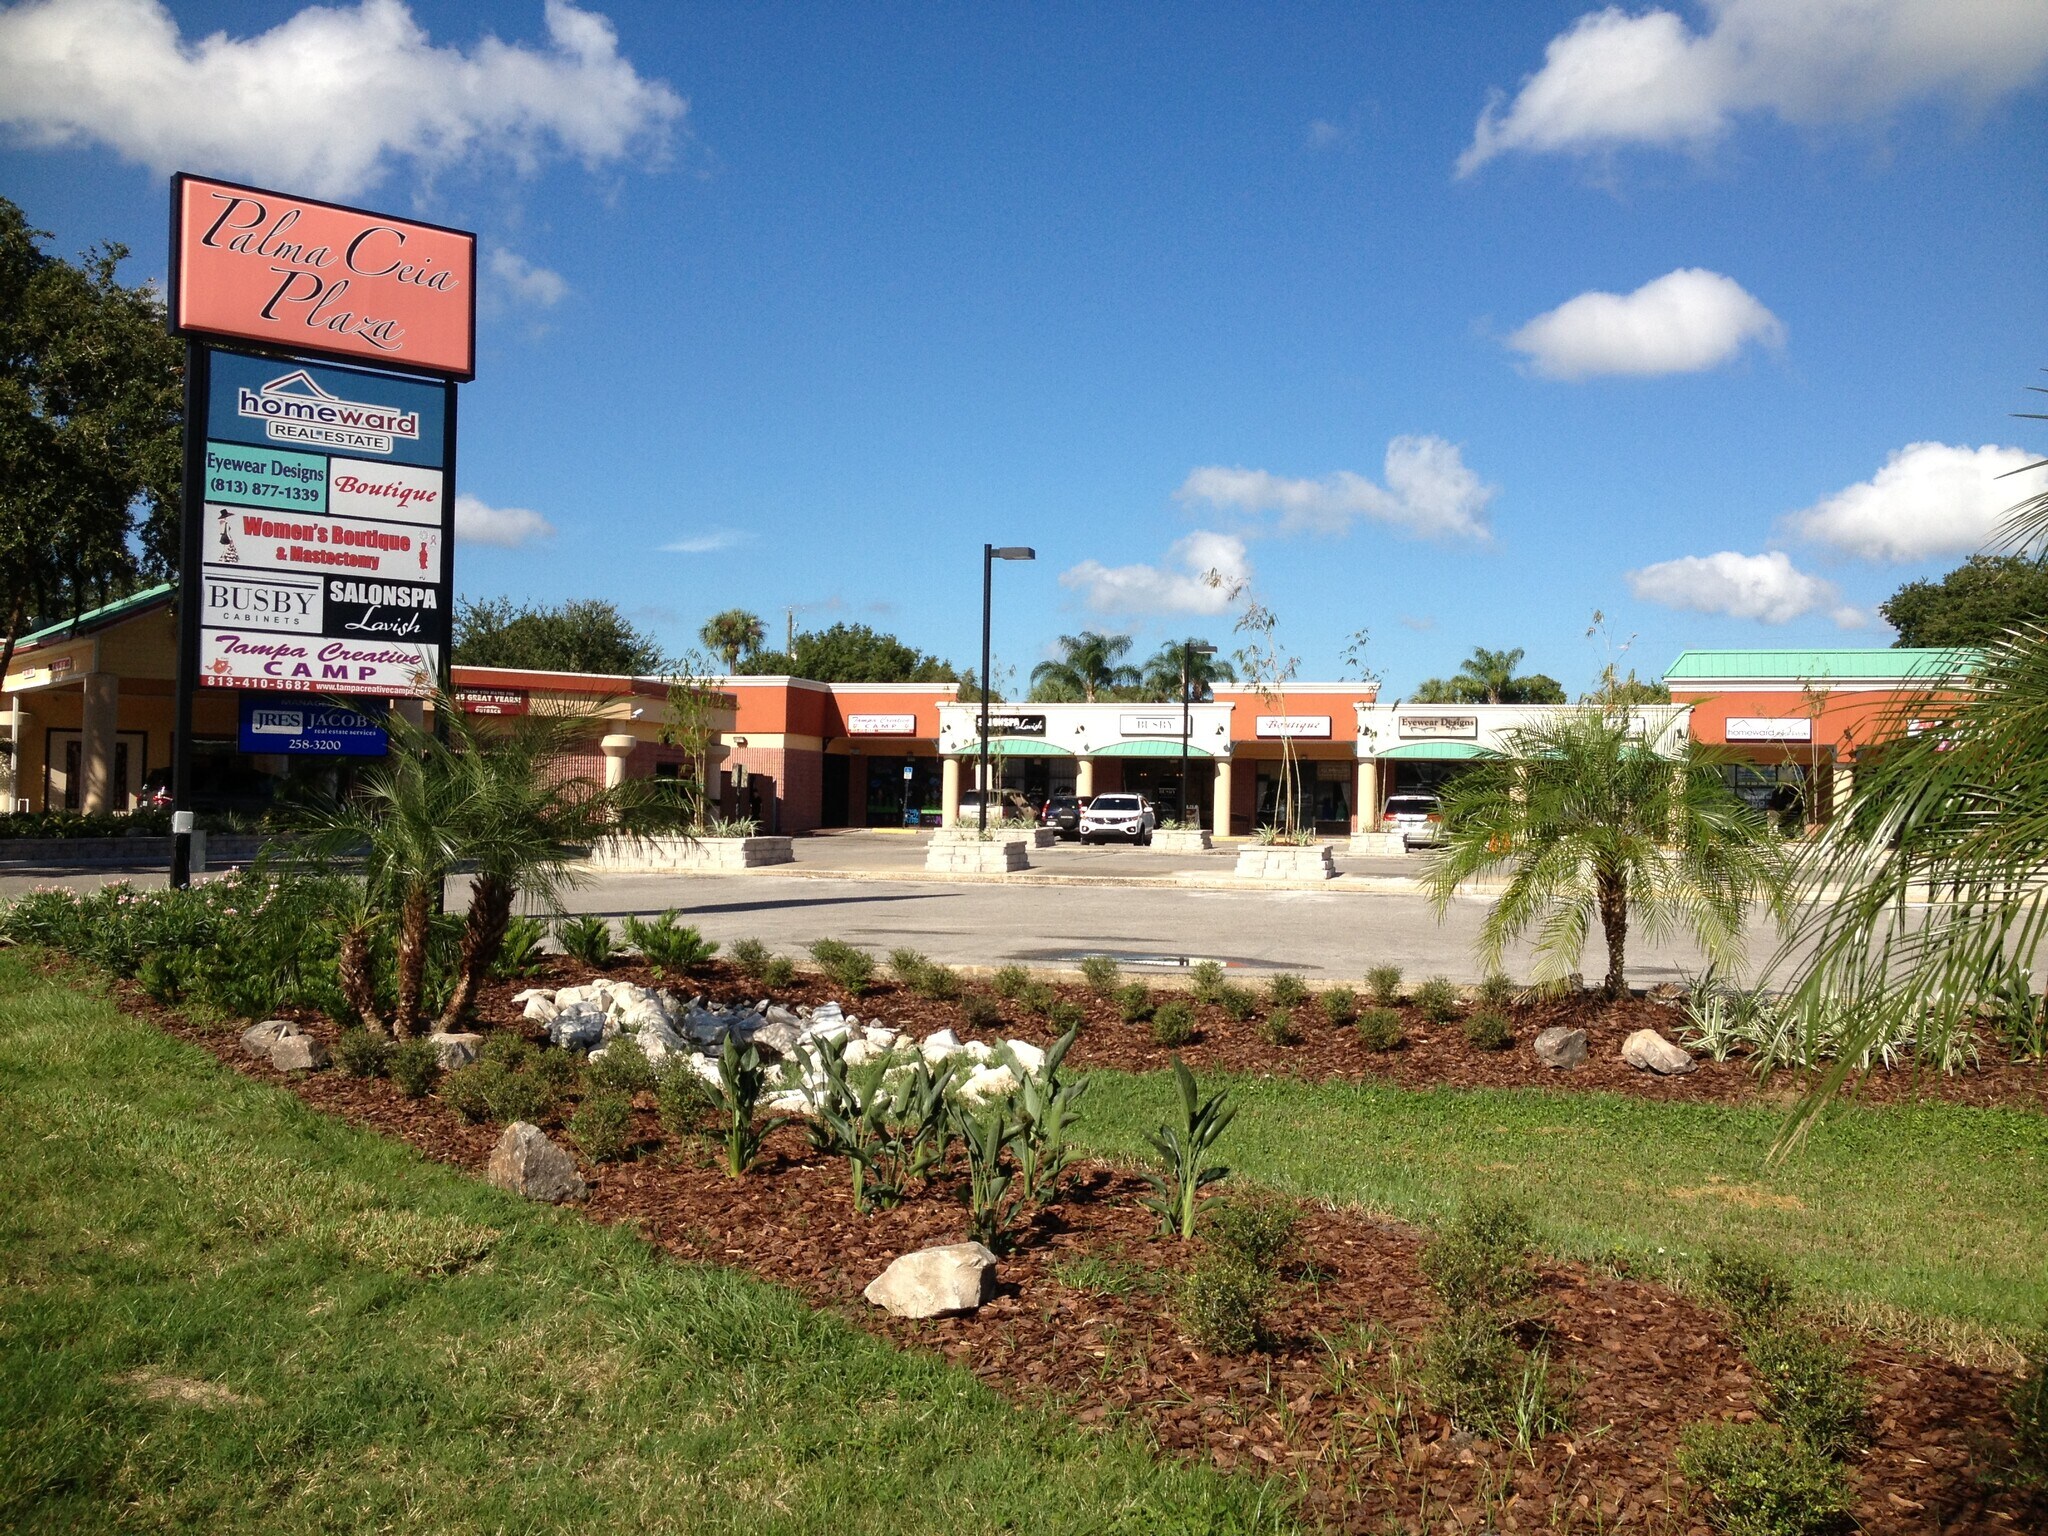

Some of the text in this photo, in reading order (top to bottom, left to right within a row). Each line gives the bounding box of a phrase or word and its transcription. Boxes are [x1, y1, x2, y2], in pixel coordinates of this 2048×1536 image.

[201, 192, 460, 293] Palma Ceia
[259, 265, 405, 353] Plaza
[240, 389, 417, 435] homeward
[275, 424, 385, 449] REAL ESTATE
[207, 452, 324, 483] Eyewear Designs
[210, 477, 319, 502] (813) 877-1339
[334, 475, 438, 508] Boutique
[243, 516, 411, 552] Women's Boutique
[275, 546, 380, 570] & Mastectomy
[208, 584, 317, 616] BUSBY
[329, 580, 438, 610] SALONSPA
[222, 612, 300, 626] CABINETS
[344, 604, 422, 637] Lavish
[215, 634, 422, 666] Tampa Creative
[263, 660, 378, 681] CAMP
[207, 676, 311, 691] 813-410-5682
[467, 694, 492, 702] GREAT
[255, 712, 378, 730] JRES JACOB
[328, 728, 349, 736] estate
[349, 729, 377, 737] services
[1266, 720, 1320, 733] Boutique
[1401, 718, 1474, 727] Eyewear Designs
[1728, 729, 1775, 737] homeward
[288, 739, 342, 751] 258-3200
